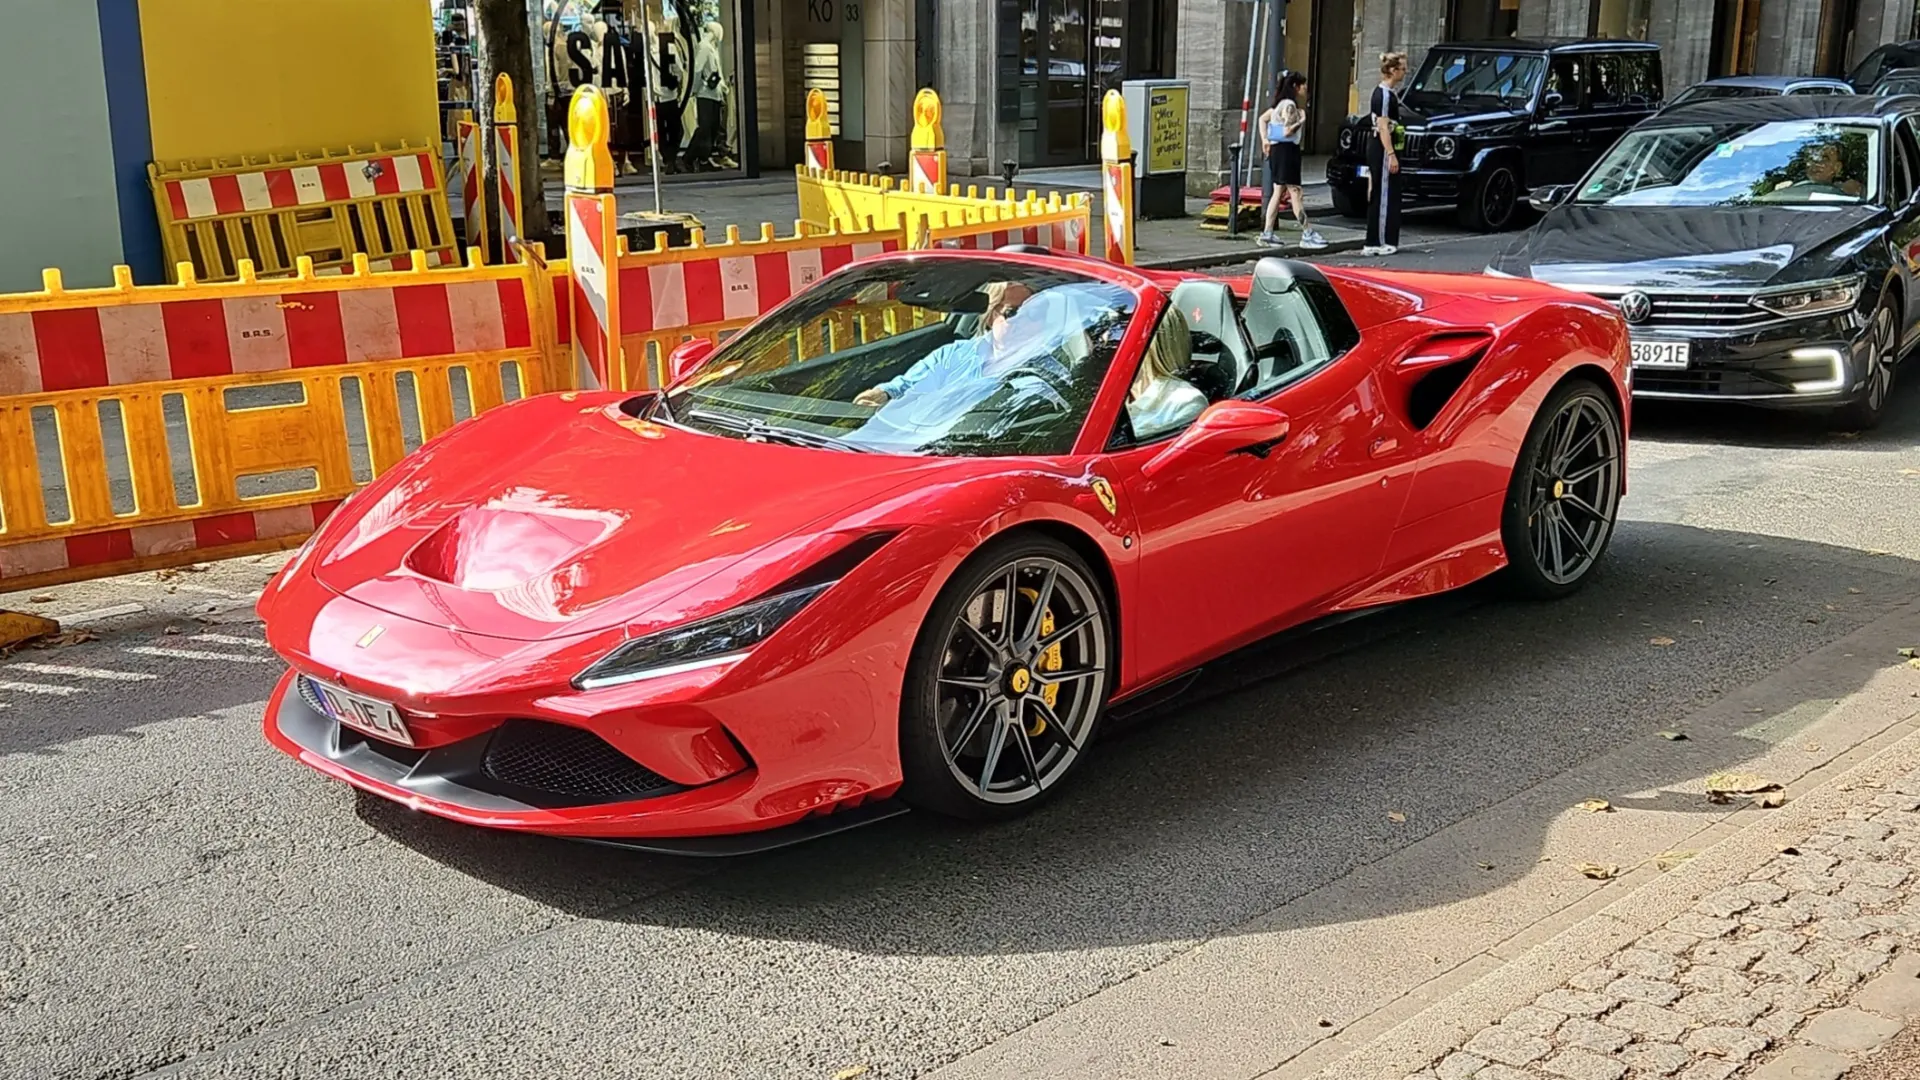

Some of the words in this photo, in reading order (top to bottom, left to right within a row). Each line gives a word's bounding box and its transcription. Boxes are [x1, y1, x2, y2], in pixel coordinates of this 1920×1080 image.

[846, 4, 859, 21] 33
[1632, 343, 1687, 363] 3891E
[387, 709, 406, 738] 4
